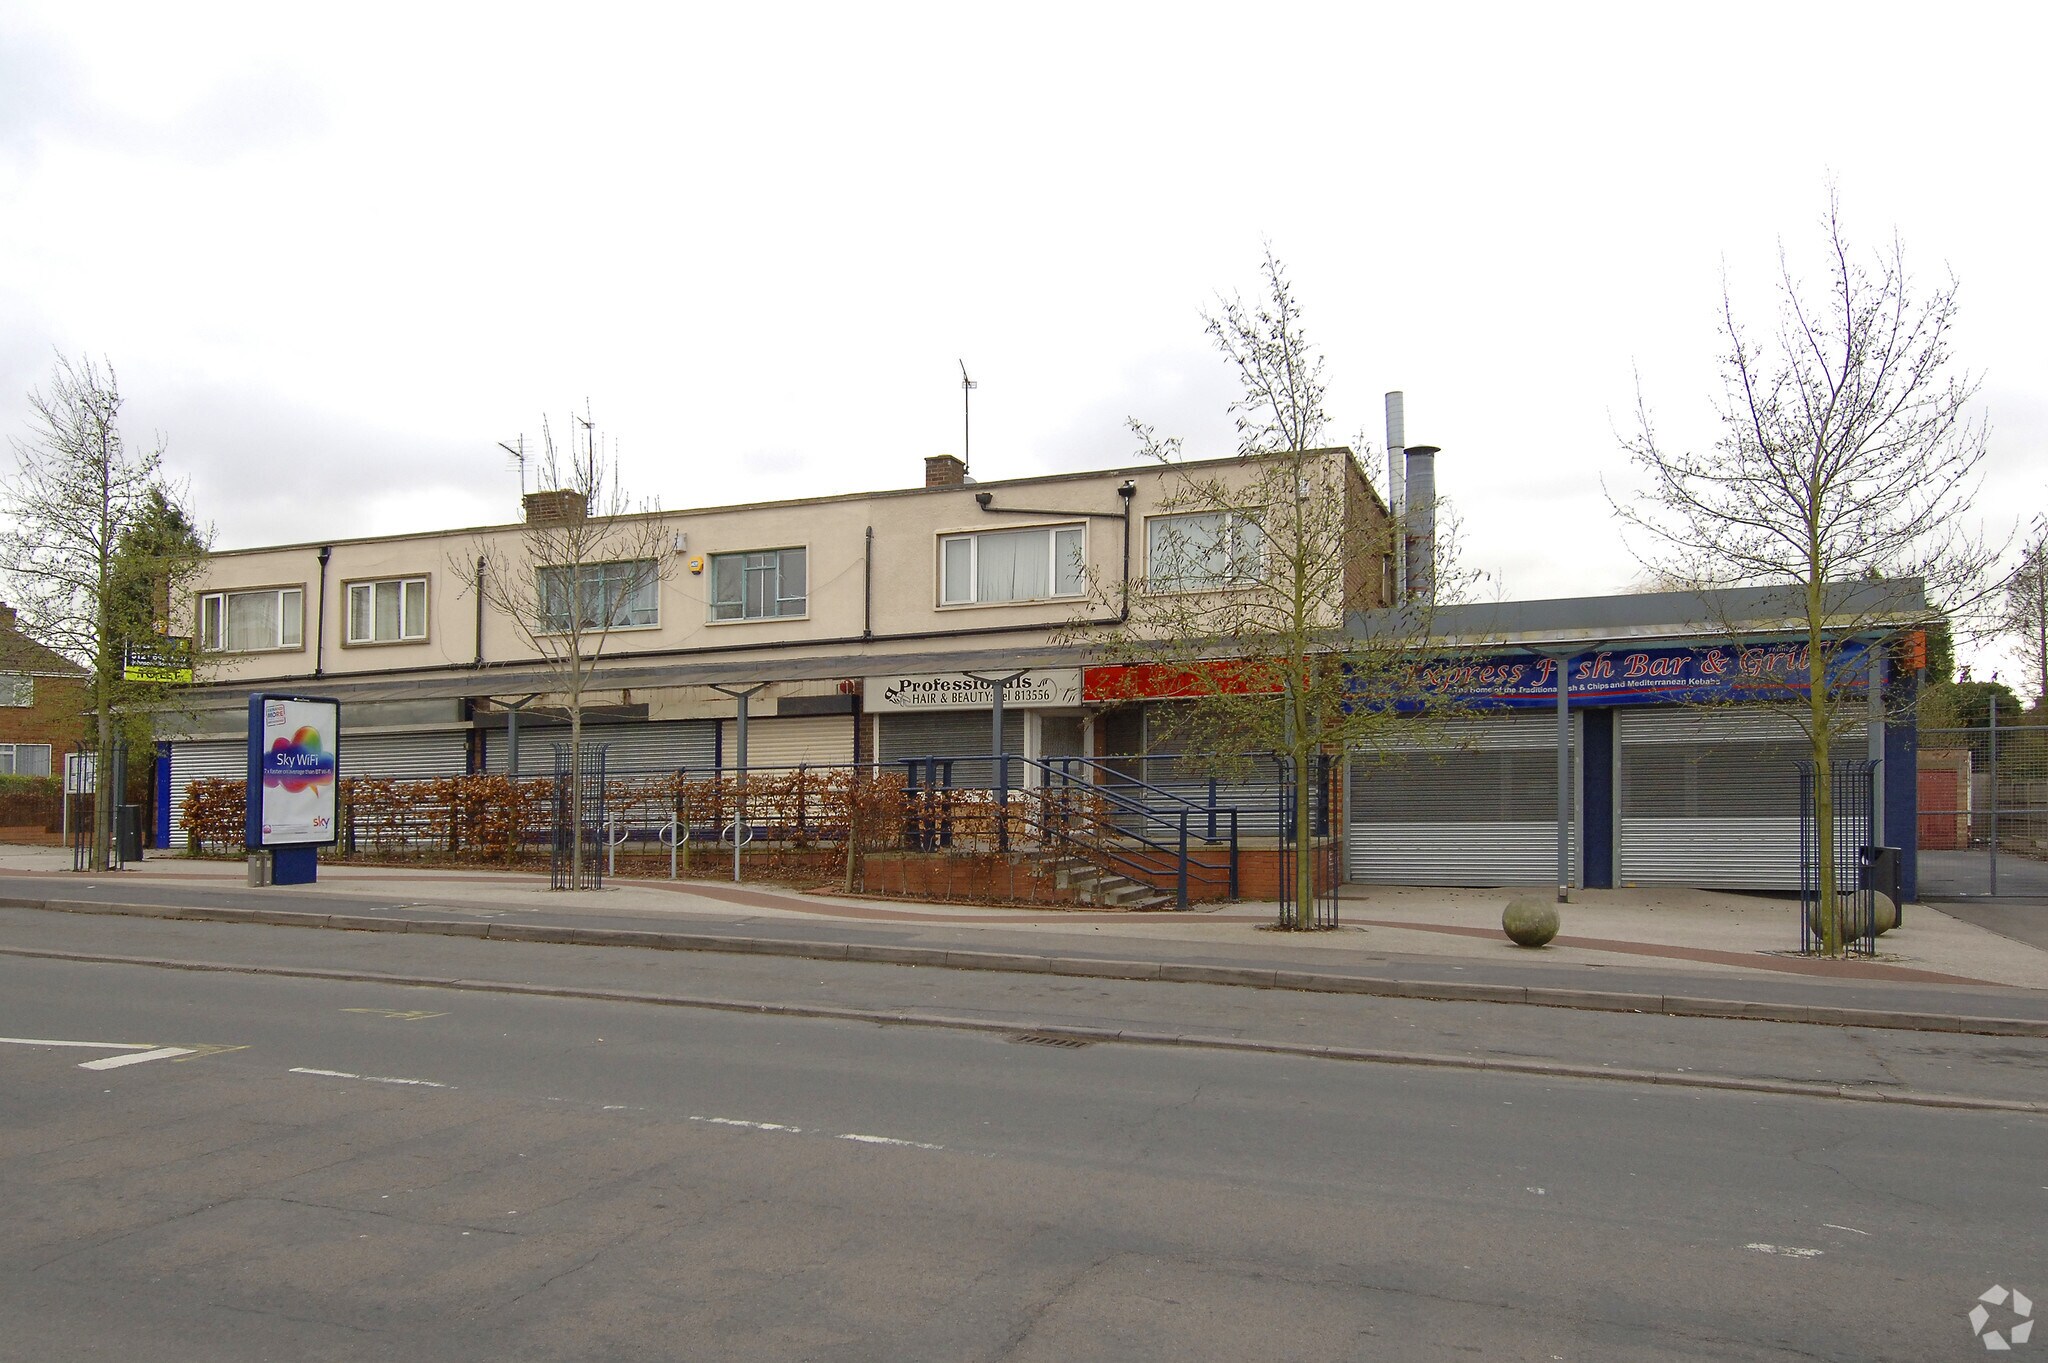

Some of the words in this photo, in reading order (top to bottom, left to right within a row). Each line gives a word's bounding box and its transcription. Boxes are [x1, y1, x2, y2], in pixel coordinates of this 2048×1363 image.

[1532, 652, 1615, 687] Fsh
[1624, 653, 1691, 677] Bar
[1701, 650, 1729, 674] &
[899, 676, 1032, 693] Professioals
[1587, 682, 1610, 692] Chips
[1610, 680, 1626, 689] and
[1627, 678, 1687, 688] Mediterranean
[912, 693, 937, 704] HAIR
[941, 692, 948, 704] &
[952, 691, 993, 703] BEAUTY:
[1014, 689, 1050, 701] 813556
[276, 753, 296, 767] Sky
[297, 753, 319, 766] WiFi
[313, 815, 330, 829] sky
